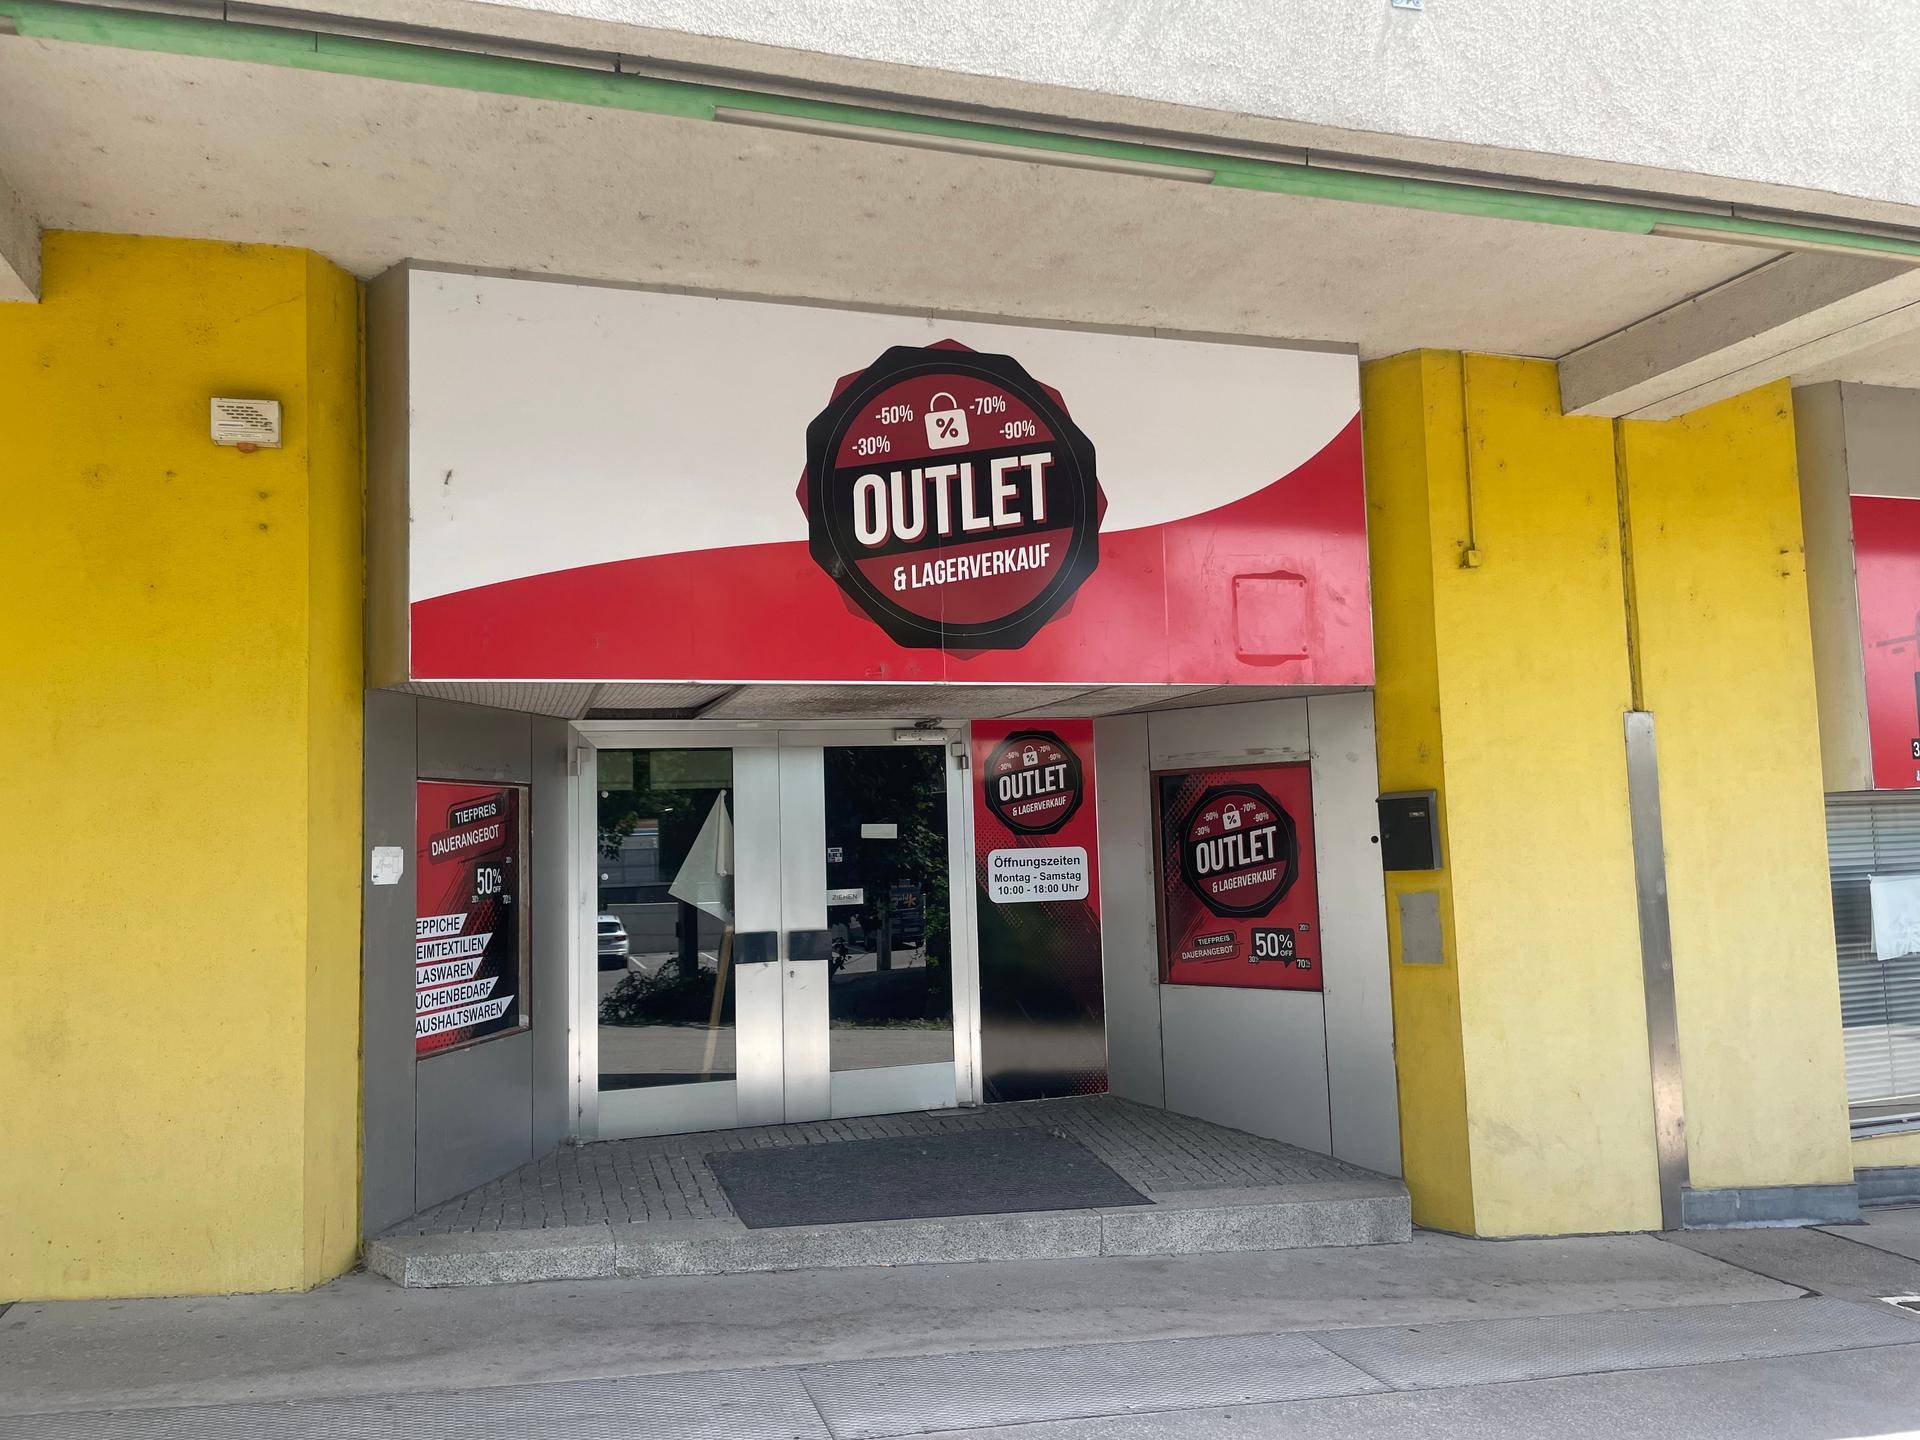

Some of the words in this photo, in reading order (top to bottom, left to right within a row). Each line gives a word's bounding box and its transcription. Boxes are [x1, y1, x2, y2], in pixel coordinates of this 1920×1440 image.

[875, 404, 913, 425] -50%
[969, 395, 1006, 416] -70%
[999, 420, 1036, 440] -90%
[851, 435, 890, 456] -30%
[852, 452, 1052, 546] OUTLET
[893, 566, 906, 591] &
[911, 543, 1051, 589] LAGERVERKAUF
[998, 764, 1067, 801] OUTLET
[455, 803, 497, 824] TIEFPREIS
[1012, 806, 1018, 816] &
[1018, 795, 1067, 816] LAGERVERKAUF
[1240, 802, 1256, 812] -70%
[431, 824, 500, 856] DAUERANGEBOT
[1196, 825, 1277, 874] OUTLET
[994, 855, 1081, 869] Öffnungszeiten
[477, 867, 502, 895] 50%
[994, 872, 1031, 884] Montag
[1039, 871, 1082, 882] Samstag
[1212, 881, 1218, 893] &
[1219, 868, 1278, 892] LAGERVERKAUF
[998, 885, 1024, 895] 10:00
[1033, 884, 1059, 894] 18:00
[1062, 883, 1079, 893] Uhr
[416, 916, 460, 935] EPPICHE
[416, 937, 485, 960] EIMTEXTILIEN
[1198, 934, 1231, 946] TIEFPREIS
[1255, 932, 1293, 957] 50%
[1181, 945, 1233, 960] DAUERANGEBOT
[1280, 949, 1293, 957] OFF
[416, 961, 474, 985] LASWAREN
[416, 981, 492, 1010] ÜCHENBEDARF
[416, 1000, 503, 1034] AUSHALTSWAREN
